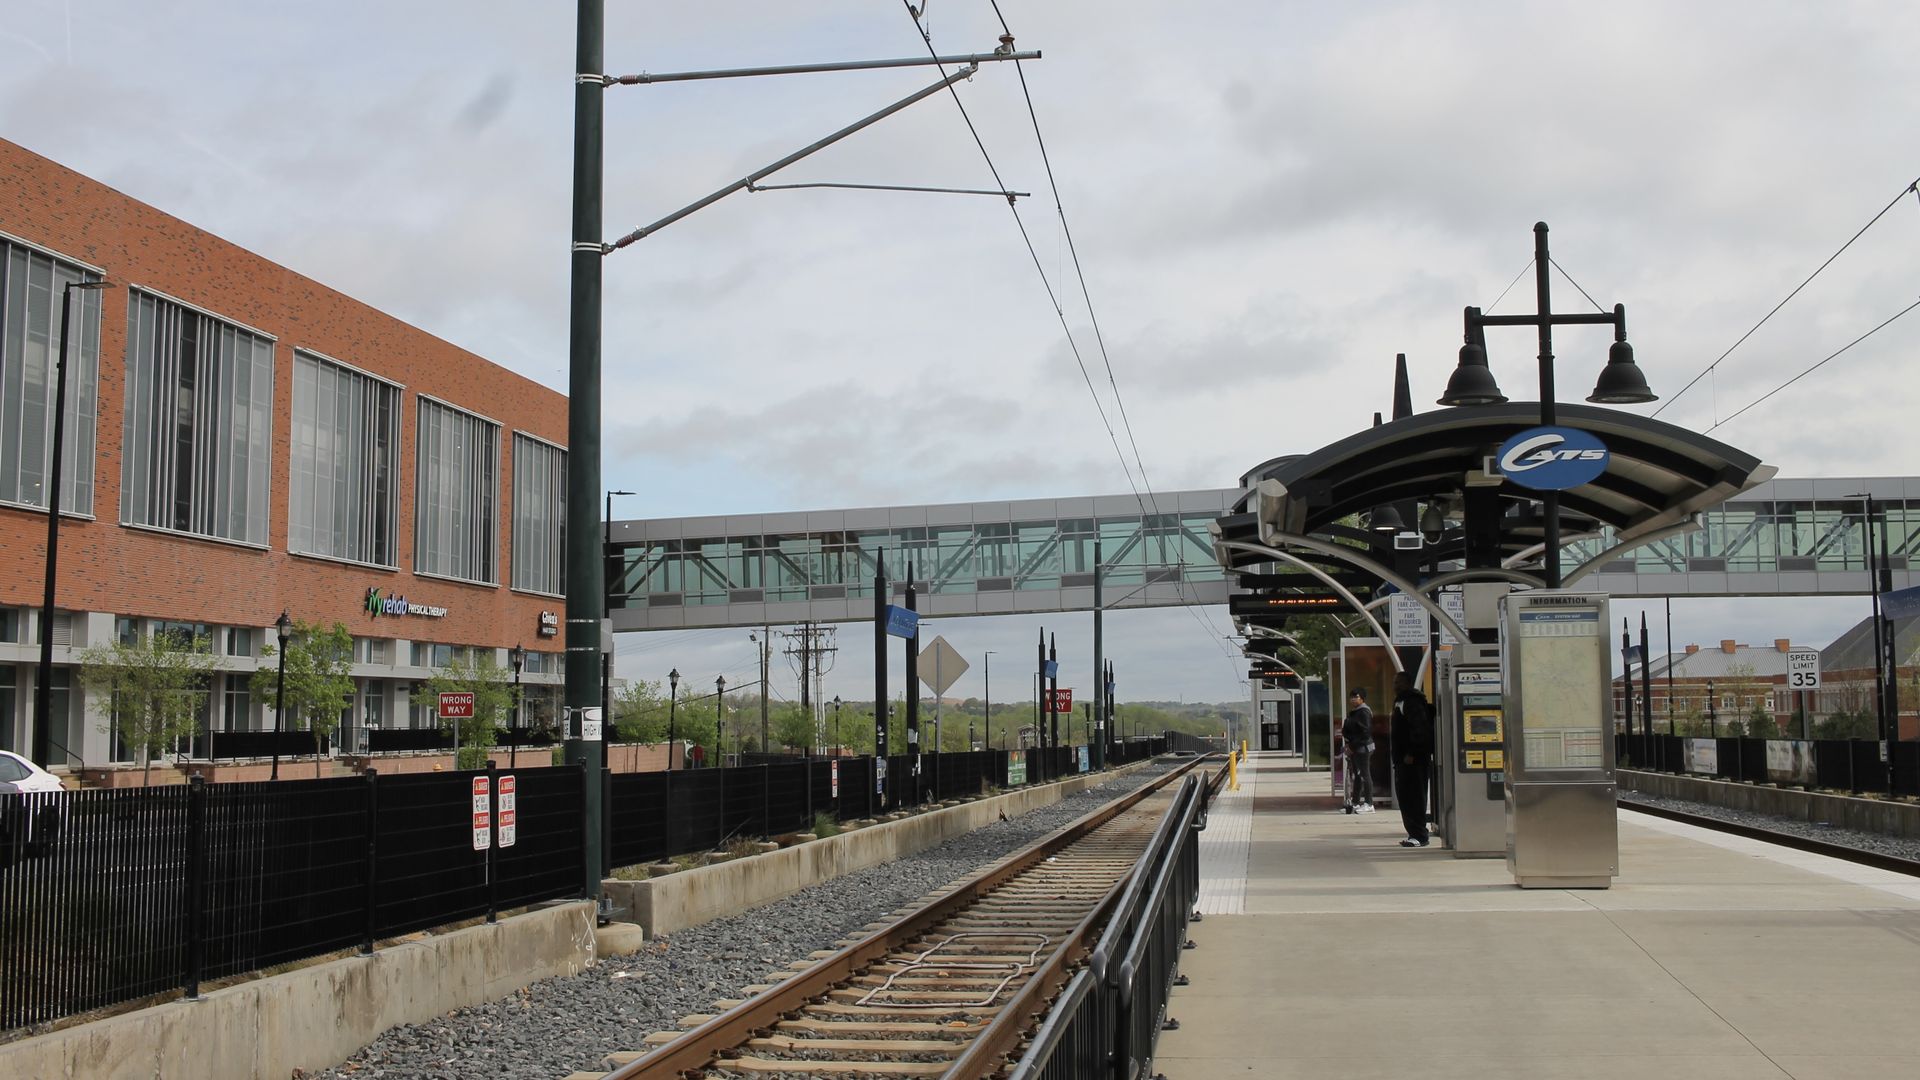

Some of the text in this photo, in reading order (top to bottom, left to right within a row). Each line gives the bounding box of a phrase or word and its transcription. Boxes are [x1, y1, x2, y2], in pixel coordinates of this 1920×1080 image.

[1501, 434, 1606, 471] CATS
[1529, 597, 1587, 605] INFORMATION
[407, 603, 429, 615] PHYSICAL
[428, 606, 448, 617] THERAPY
[1793, 672, 1817, 687] 35
[442, 696, 472, 704] WRONG
[1045, 692, 1071, 700] WONG
[447, 706, 466, 714] WAY
